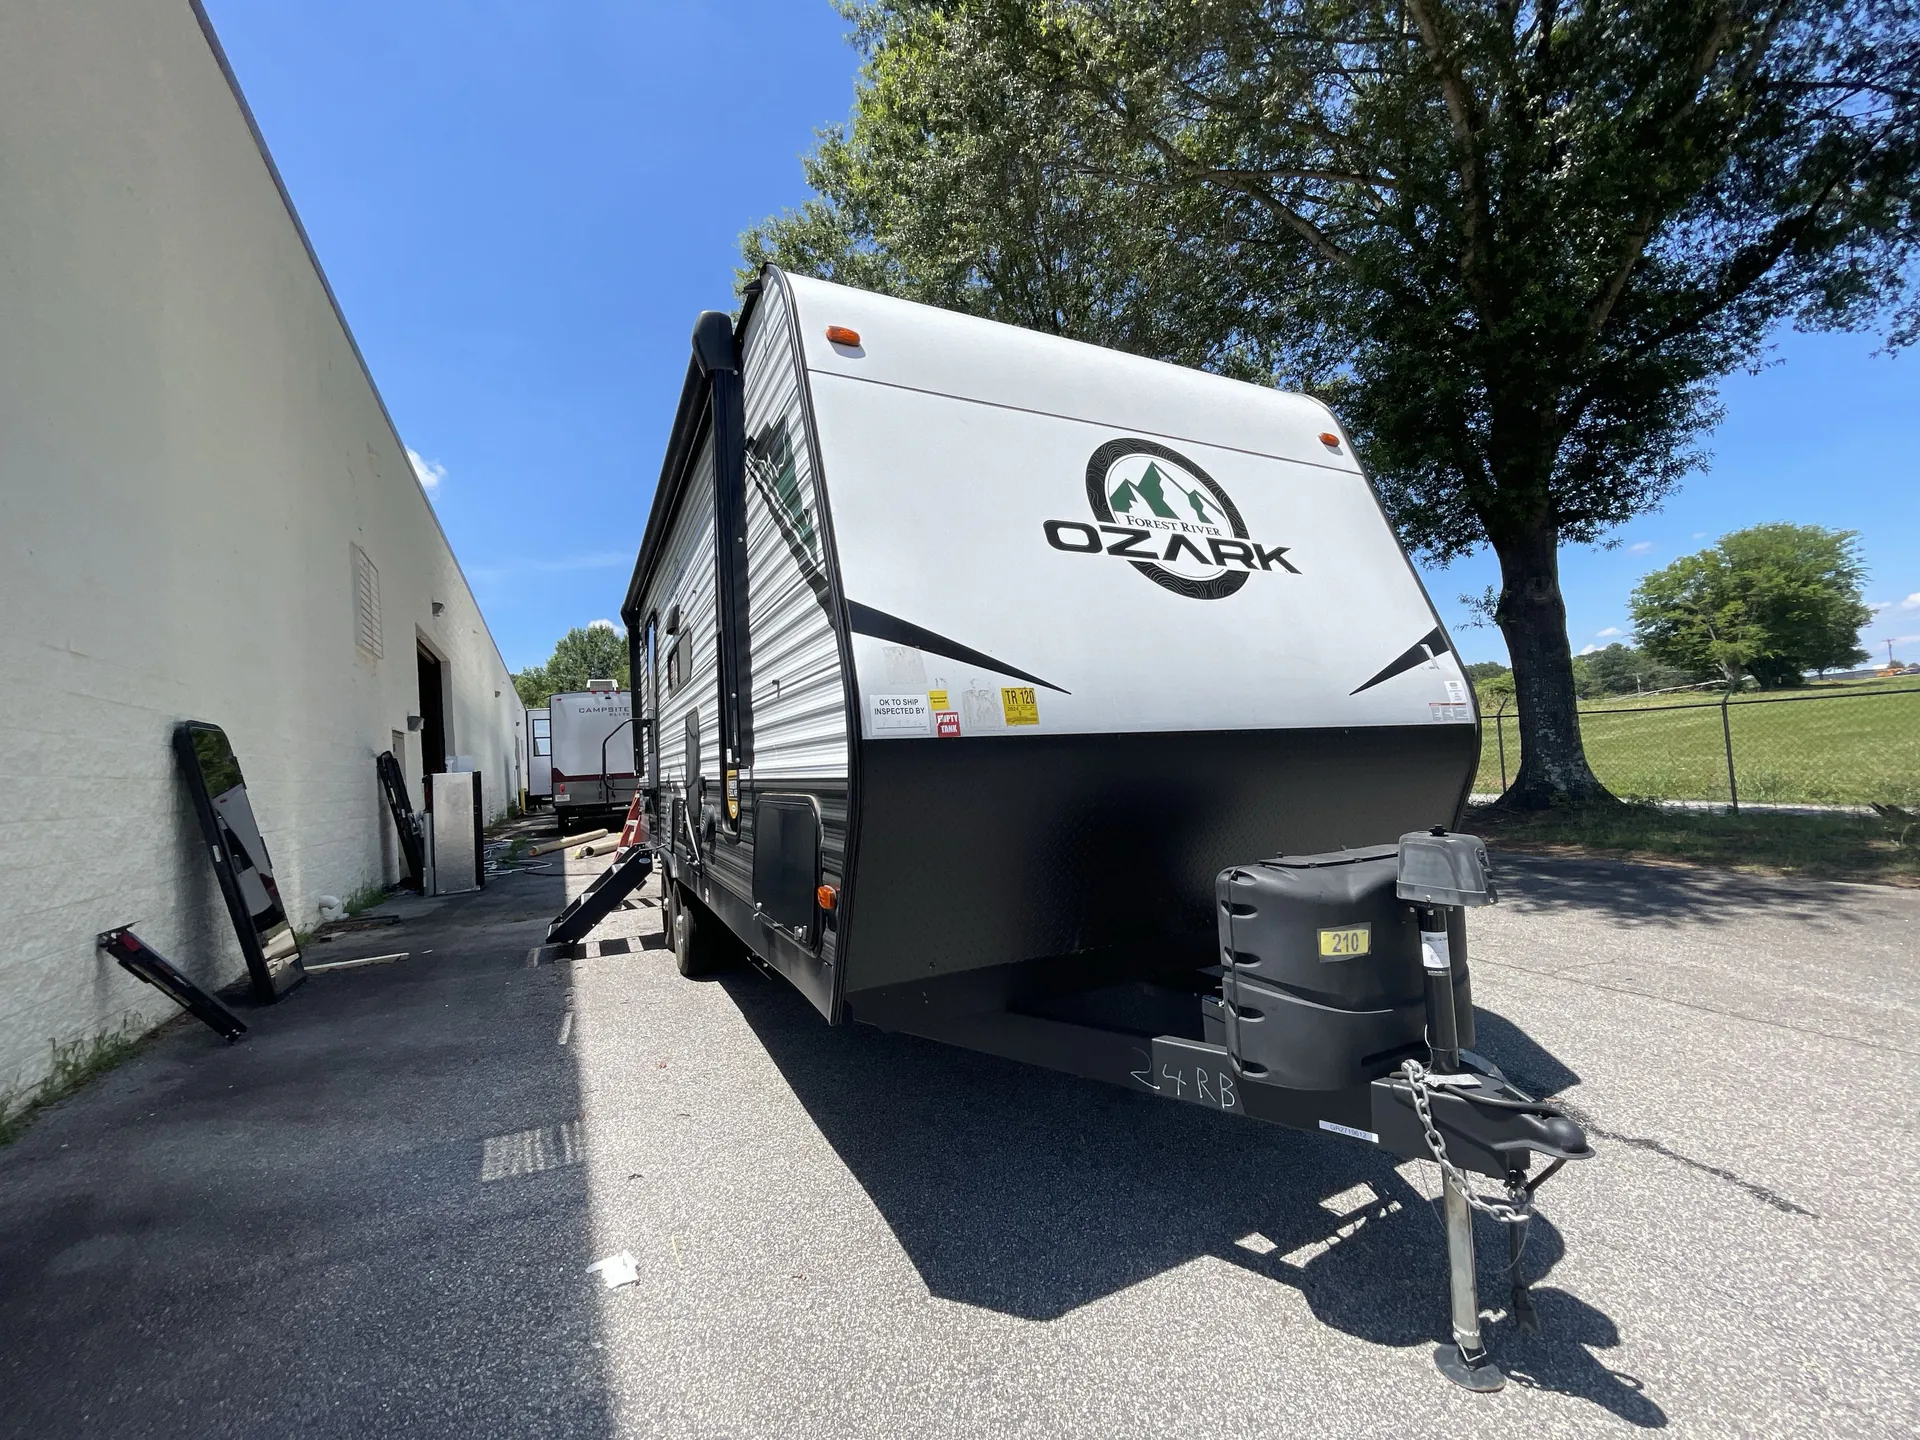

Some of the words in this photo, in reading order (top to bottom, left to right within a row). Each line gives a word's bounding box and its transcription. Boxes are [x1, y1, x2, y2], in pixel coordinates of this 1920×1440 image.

[1125, 515, 1178, 531] FOREST
[1181, 522, 1222, 536] RIVER
[1043, 519, 1303, 575] OZARK
[879, 698, 890, 706] OK
[891, 698, 902, 706] TO
[903, 698, 919, 706] SHIP
[1005, 690, 1019, 705] TR
[1020, 690, 1035, 705] 120
[940, 725, 958, 733] TANK
[1332, 932, 1359, 953] 210
